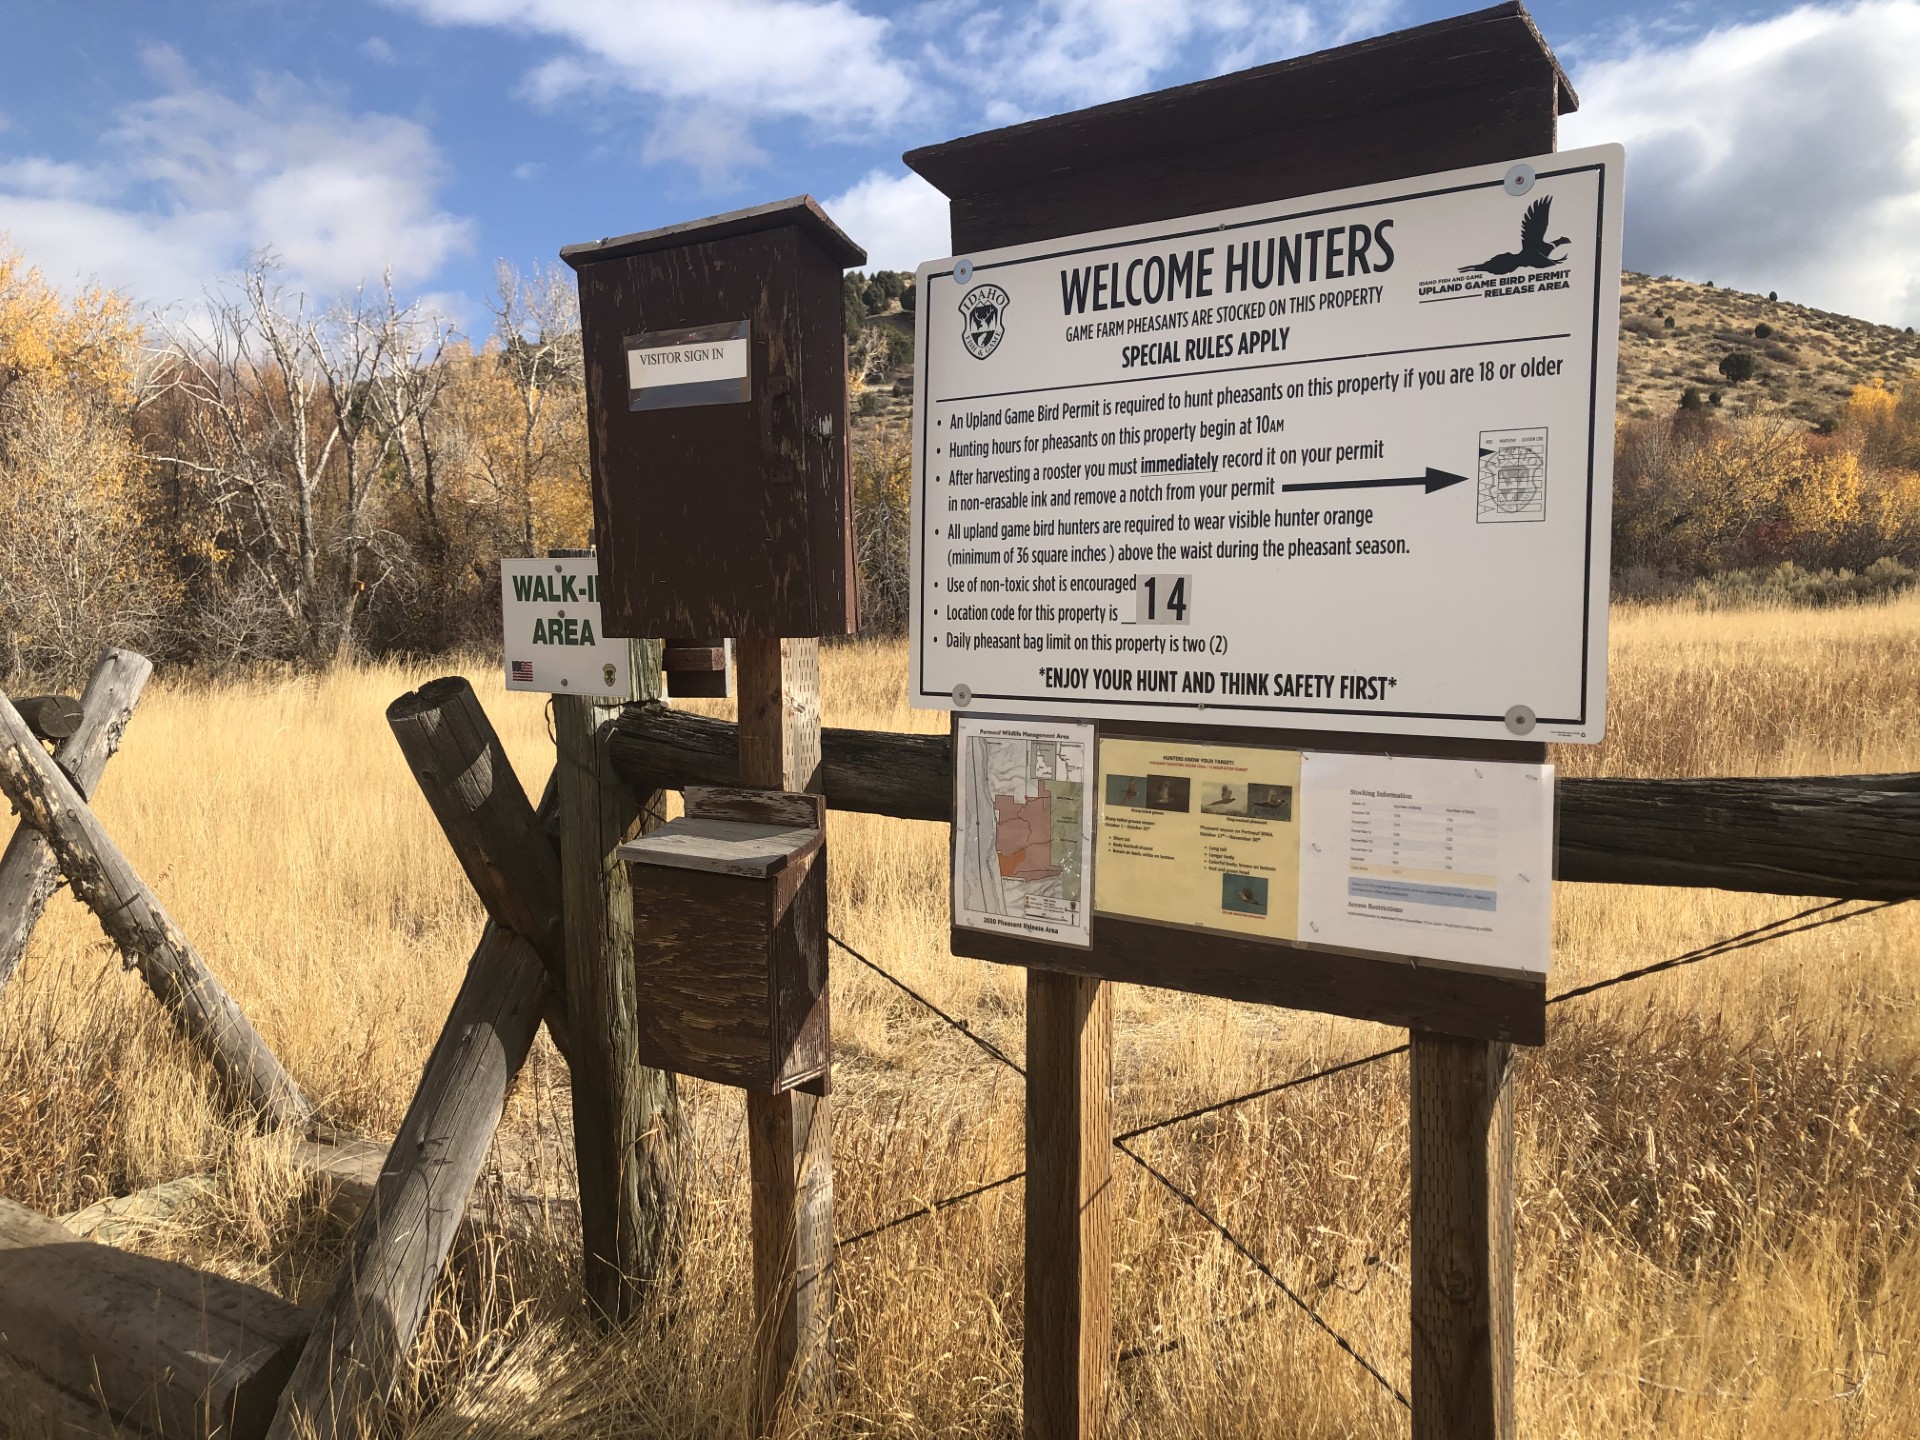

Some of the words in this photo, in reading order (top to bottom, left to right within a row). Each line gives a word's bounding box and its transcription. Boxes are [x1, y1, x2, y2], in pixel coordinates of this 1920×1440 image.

[1061, 247, 1214, 315] WELCOME
[1226, 219, 1394, 293] HUNTERS
[1418, 283, 1462, 296] UPLAND
[1465, 279, 1496, 290] GAME
[1499, 275, 1526, 287] BIRD
[1528, 270, 1571, 283] PERMIT
[1484, 284, 1534, 298] RELEASE
[1537, 281, 1570, 291] AREA
[963, 288, 1005, 310] IDAHO
[1066, 324, 1094, 342] GAME
[1097, 320, 1124, 338] FARM
[1127, 311, 1188, 334] PHEASANTS
[1191, 308, 1213, 326] ARE
[1216, 302, 1266, 323] STOCKED
[1269, 299, 1286, 316] ON
[1290, 295, 1315, 314] THIS
[1320, 286, 1383, 310] PROPERTY
[640, 351, 682, 366] VISITOR
[684, 349, 711, 363] SIGN
[712, 348, 724, 360] IN
[1122, 341, 1181, 368] SPECIAL
[1185, 334, 1233, 361] RULES
[1238, 327, 1290, 355] APPLY
[950, 414, 963, 430] An
[966, 409, 1002, 430] Upland
[1005, 408, 1034, 425] Game
[1038, 404, 1059, 422] Bird
[1062, 400, 1100, 419] Permit
[1103, 399, 1111, 415] is
[1115, 393, 1165, 416] required
[1168, 393, 1181, 409] to
[1184, 389, 1213, 408] hunt
[1217, 383, 1283, 408] pheasants
[1287, 384, 1304, 398] on
[1308, 377, 1333, 397] this
[1337, 372, 1399, 397] property
[1404, 368, 1414, 388] if
[1418, 370, 1445, 390] you
[1450, 367, 1474, 384] are
[1479, 361, 1494, 381] 18
[1500, 364, 1516, 380] or
[1521, 356, 1563, 378] older
[950, 441, 989, 458] Hunting
[992, 439, 1021, 454] hours
[1024, 436, 1039, 452] for
[1042, 431, 1098, 453] pheasants
[1102, 432, 1115, 446] on
[1119, 427, 1140, 445] this
[1144, 423, 1196, 446] property
[1200, 419, 1235, 440] begin
[1240, 418, 1252, 435] at
[949, 470, 973, 486] After
[976, 466, 1030, 484] harvesting
[1033, 468, 1039, 481] a
[1043, 463, 1081, 480] rooster
[1084, 464, 1105, 480] you
[1108, 458, 1137, 476] must
[1141, 452, 1219, 477] immediately
[1223, 448, 1263, 468] record
[1267, 447, 1276, 465] it
[1280, 450, 1296, 465] on
[1301, 447, 1332, 466] your
[1336, 440, 1384, 464] permit
[948, 496, 957, 511] in
[961, 492, 1028, 511] non-erasable
[1031, 491, 1047, 507] ink
[1050, 489, 1071, 506] and
[1074, 490, 1116, 505] remove
[1120, 490, 1126, 503] a
[1130, 484, 1162, 502] notch
[1166, 483, 1195, 500] from
[1200, 484, 1228, 502] your
[1231, 477, 1275, 500] permit
[948, 524, 960, 539] All
[964, 522, 998, 541] upland
[1001, 524, 1030, 540] game
[1034, 520, 1054, 536] bird
[1058, 519, 1100, 535] hunters
[1103, 521, 1121, 533] are
[1124, 514, 1174, 535] required
[1178, 514, 1190, 531] to
[1194, 516, 1225, 530] wear
[1228, 510, 1271, 529] visible
[1275, 509, 1320, 527] hunter
[1324, 509, 1373, 527] orange
[948, 549, 1000, 567] (minimum
[1004, 547, 1014, 564] of
[1017, 547, 1029, 563] 36
[1032, 549, 1068, 565] square
[1118, 544, 1153, 561] above
[1157, 543, 1176, 560] the
[1180, 542, 1212, 559] waist
[1216, 540, 1258, 560] during
[1263, 539, 1284, 557] the
[1288, 537, 1352, 559] pheasant
[1356, 539, 1410, 555] season.
[947, 577, 965, 592] Use
[967, 577, 977, 592] of
[981, 576, 1030, 592] non-toxic
[1032, 576, 1056, 592] shot
[1059, 575, 1067, 591] is
[1070, 574, 1136, 594] encouraged
[947, 604, 988, 620] Location
[991, 605, 1015, 620] code
[1018, 605, 1032, 620] for
[1036, 605, 1055, 621] this
[1058, 605, 1106, 624] property
[1110, 604, 1118, 621] is
[532, 619, 596, 647] AREA
[947, 632, 971, 650] Daily
[974, 633, 1021, 651] pheasant
[1024, 633, 1043, 652] bag
[1046, 633, 1071, 650] limit
[1074, 638, 1088, 650] on
[1091, 634, 1112, 651] this
[1116, 635, 1166, 654] property
[1170, 635, 1179, 652] is
[1182, 636, 1206, 652] two
[1210, 635, 1228, 655] (2)
[1093, 669, 1132, 691] YOUR
[1137, 670, 1178, 692] HUNT
[1182, 671, 1215, 693] AND
[1220, 672, 1269, 696] THINK
[1274, 674, 1335, 698] SAFETY
[1350, 789, 1375, 798] Stocking
[1377, 791, 1412, 799] Information
[1347, 901, 1367, 909] Access
[1368, 904, 1403, 913] Restrictions
[998, 919, 1022, 928] Pheasant
